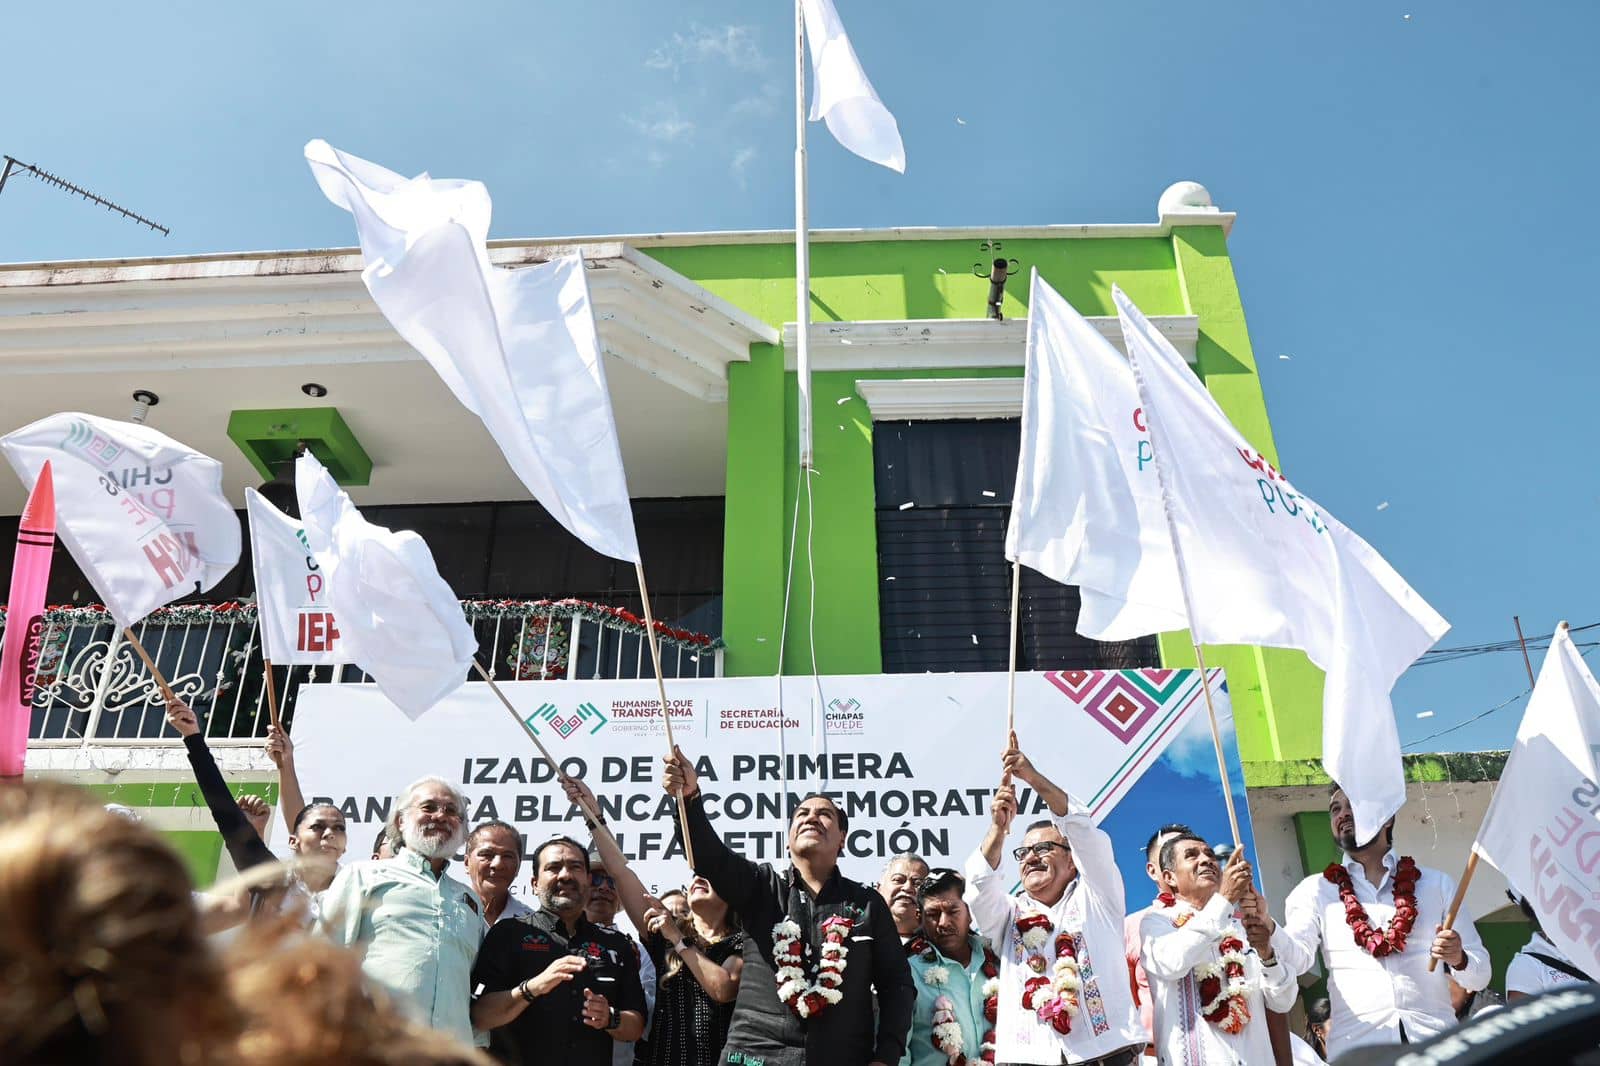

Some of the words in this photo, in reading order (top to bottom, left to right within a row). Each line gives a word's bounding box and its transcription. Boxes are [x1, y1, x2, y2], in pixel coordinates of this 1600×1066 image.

[23, 621, 43, 700] CRAYON
[611, 699, 672, 709] HUMANISMO
[672, 699, 694, 708] QUE
[611, 707, 694, 718] TRANSFORMA
[719, 707, 784, 719] SECRETARÍA
[825, 712, 864, 721] CHIAPAS
[719, 720, 735, 730] DE
[736, 717, 800, 729] EDUCACIÓN
[826, 720, 864, 730] PUEDE
[462, 756, 588, 785] IZADO
[601, 756, 654, 783] DE
[732, 752, 914, 782] PRIMERA
[514, 793, 678, 822] BLANCA
[700, 787, 1049, 821] CONMORATV
[587, 821, 950, 861] LFAETICIÓN
